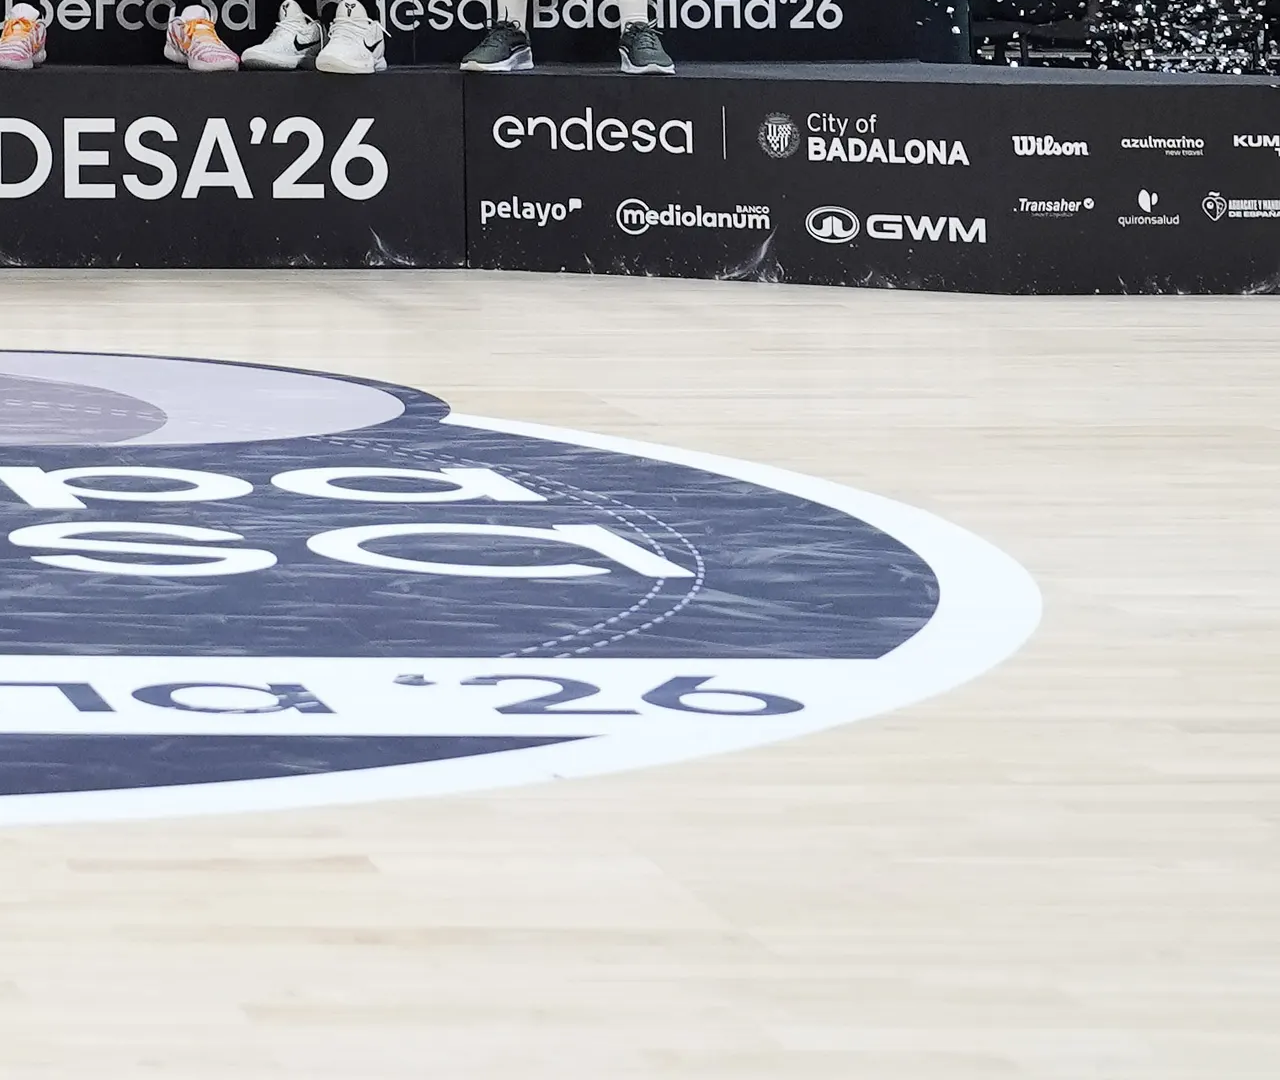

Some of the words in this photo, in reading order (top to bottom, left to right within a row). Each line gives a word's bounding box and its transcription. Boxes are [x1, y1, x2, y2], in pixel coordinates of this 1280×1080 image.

[492, 106, 694, 154] endesa
[806, 112, 851, 136] City
[856, 113, 877, 134] of
[807, 136, 970, 166] BADALONA
[1011, 134, 1090, 156] Wilson
[1121, 135, 1205, 149] azulmarino
[1233, 134, 1280, 148] KUM
[480, 195, 566, 226] pelayo
[622, 203, 770, 230] mediolanum
[735, 204, 770, 215] BANCO
[1228, 210, 1242, 218] DE
[865, 214, 987, 243] GWM
